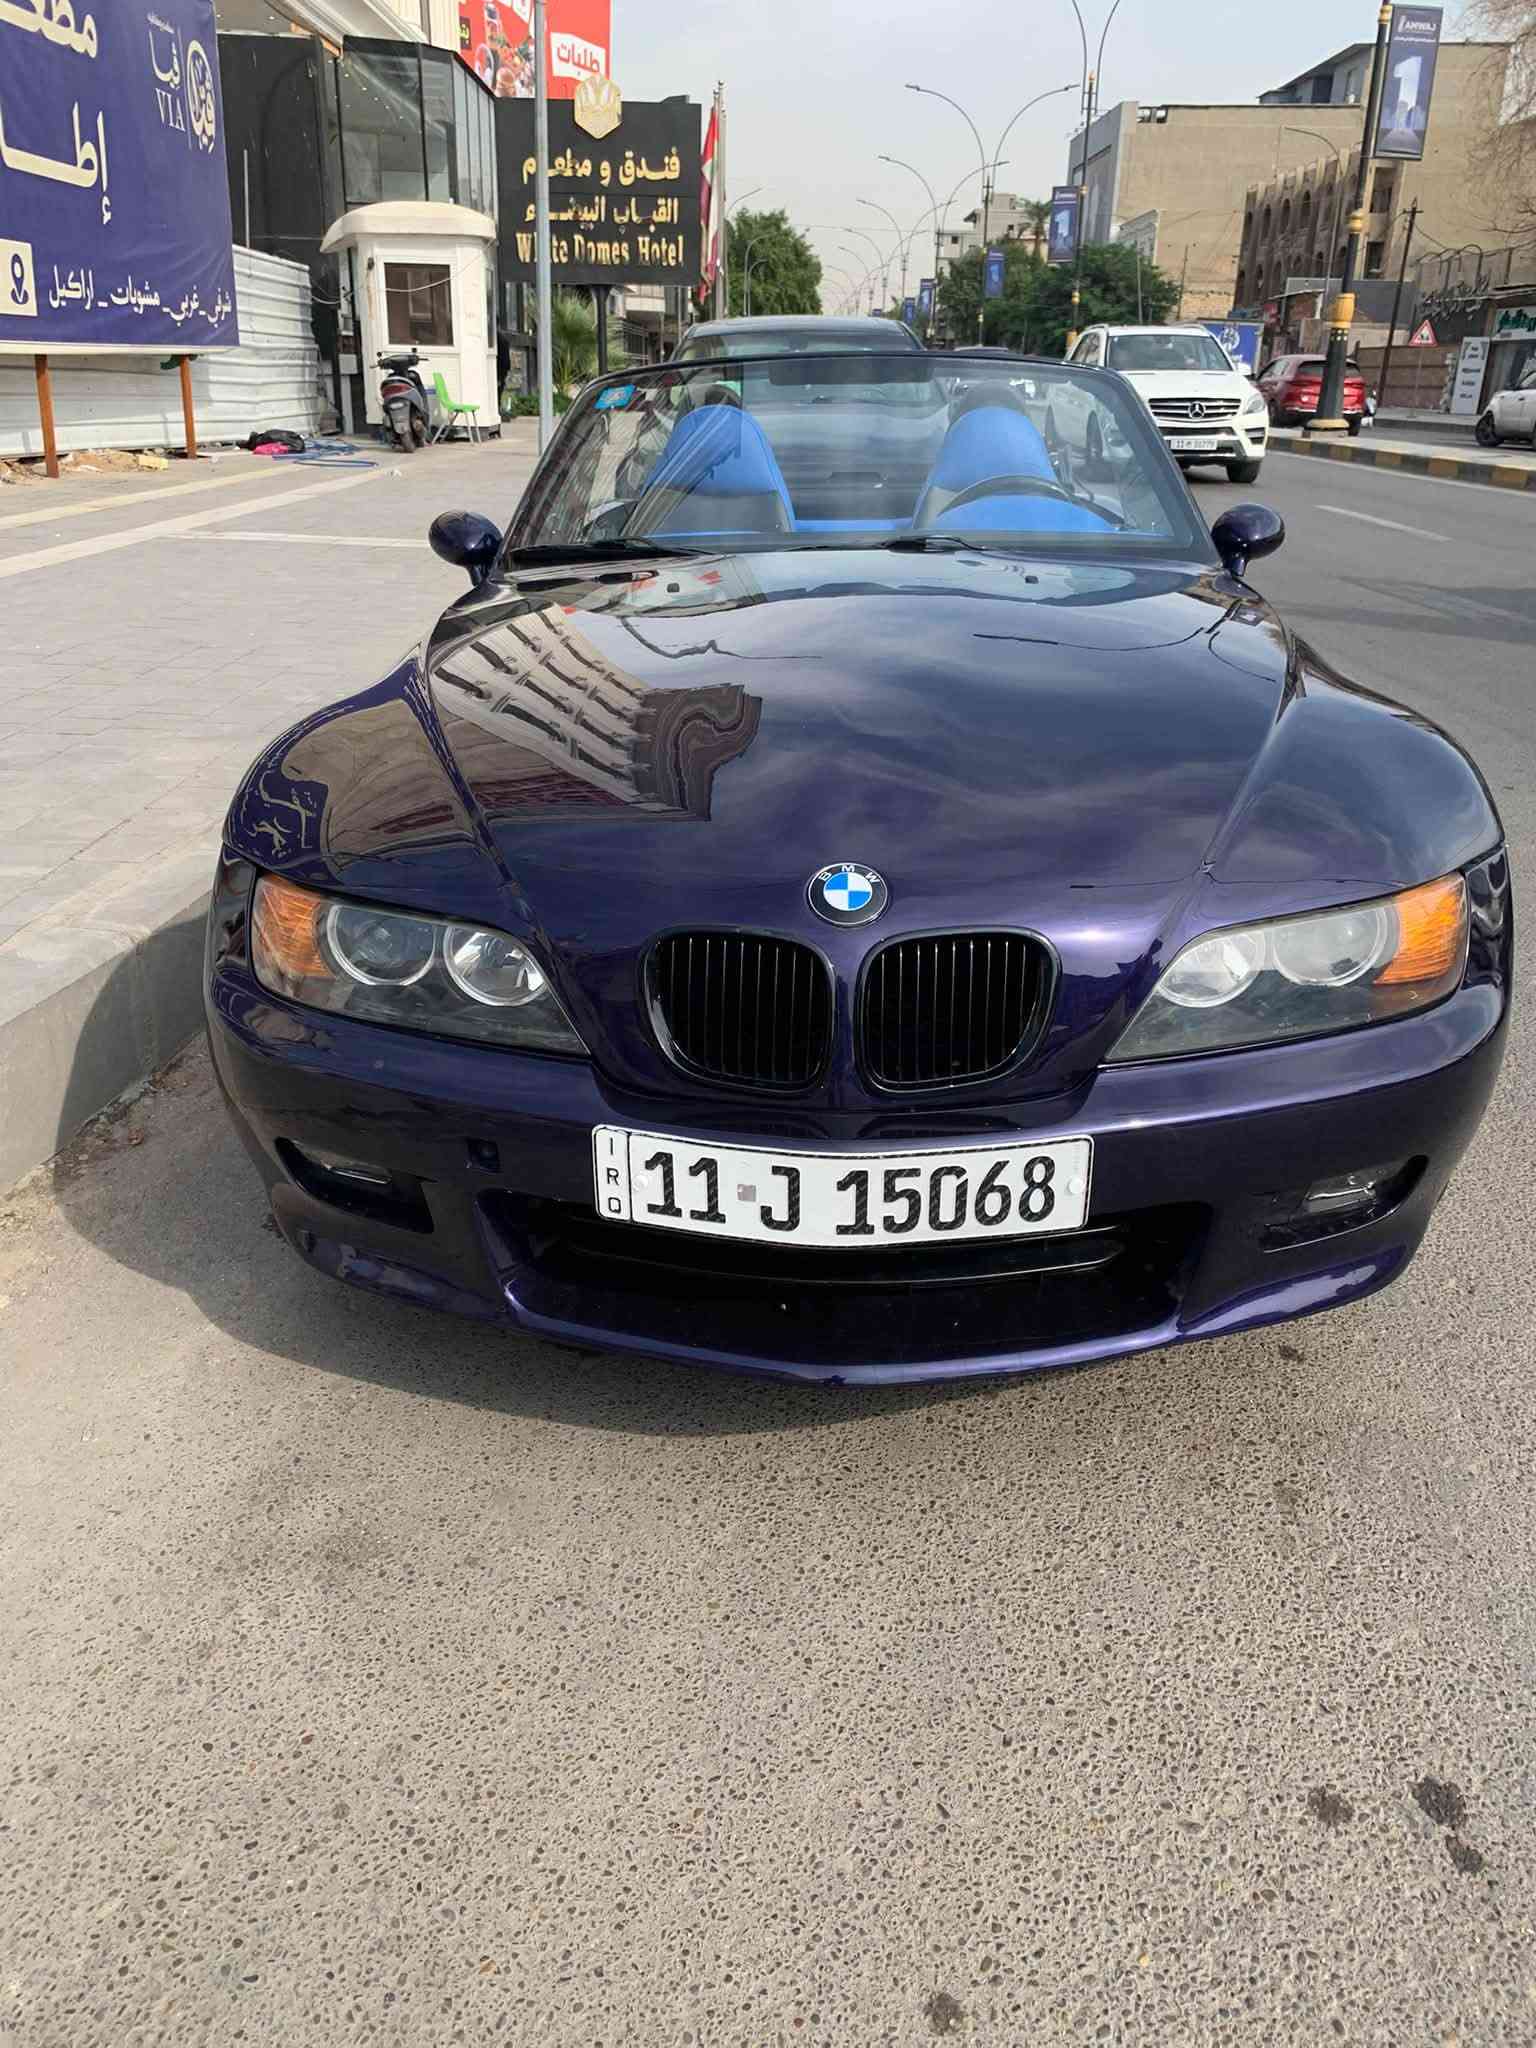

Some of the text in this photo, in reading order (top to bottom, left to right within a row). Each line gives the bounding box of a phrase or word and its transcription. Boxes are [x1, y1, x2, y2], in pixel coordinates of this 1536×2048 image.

[557, 42, 600, 77] طلبات
[155, 88, 186, 133] VIA
[600, 160, 611, 187] و
[619, 145, 681, 186] فندق
[613, 196, 679, 233] القباب
[574, 233, 630, 266] Domes
[637, 235, 684, 266] Hotel
[110, 275, 161, 314] مشويات
[168, 285, 199, 327] غربي
[817, 864, 881, 884] BMW
[605, 1136, 622, 1214] IRQ
[644, 1151, 726, 1225] 11
[760, 1165, 801, 1231] J
[834, 1154, 1057, 1236] 15068
